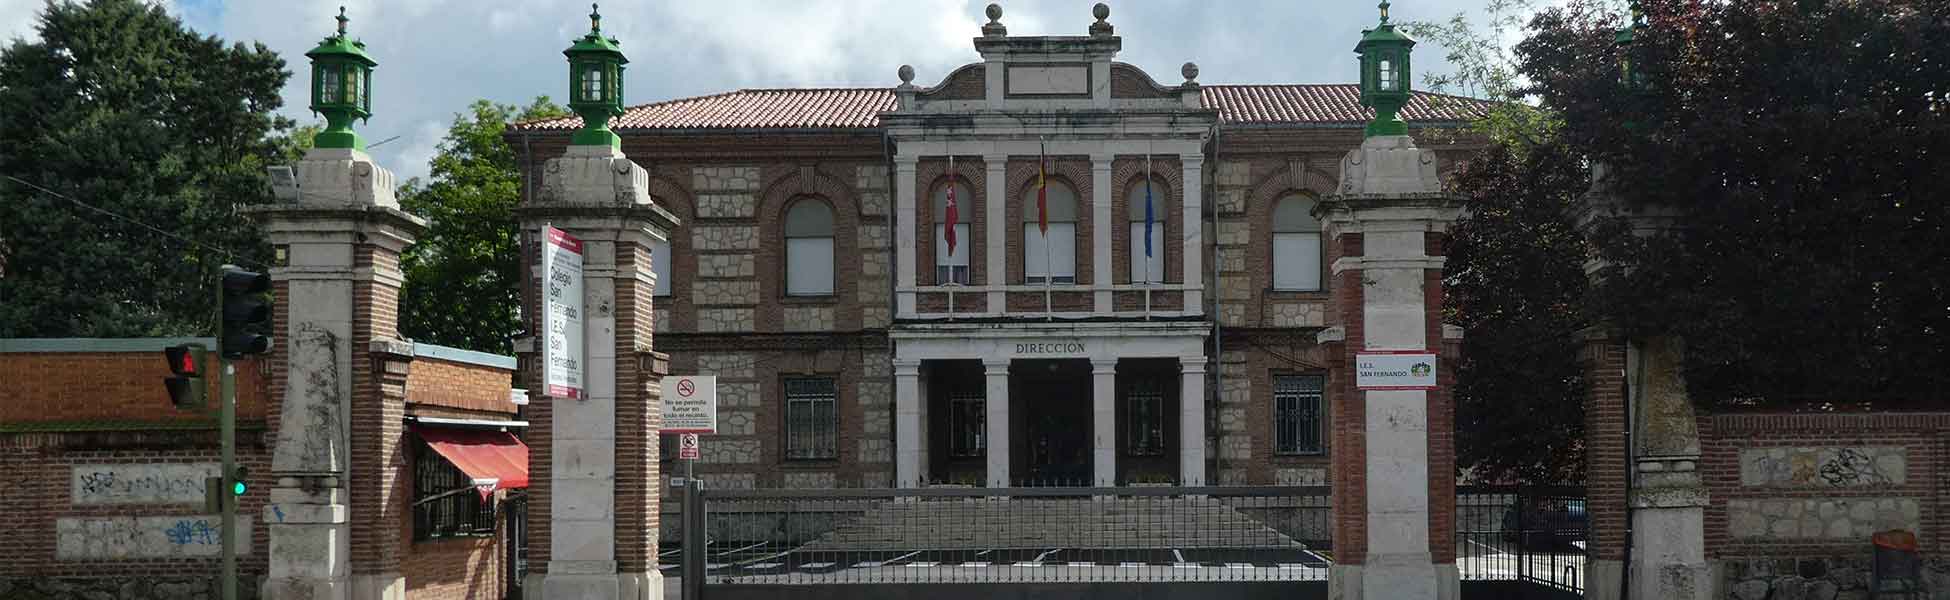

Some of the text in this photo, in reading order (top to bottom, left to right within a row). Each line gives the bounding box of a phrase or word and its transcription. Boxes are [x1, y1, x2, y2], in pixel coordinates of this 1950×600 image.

[551, 265, 571, 287] Colegio
[551, 282, 561, 297] San
[551, 299, 577, 320] Fernando
[551, 335, 561, 351] San
[551, 352, 577, 370] Fernando
